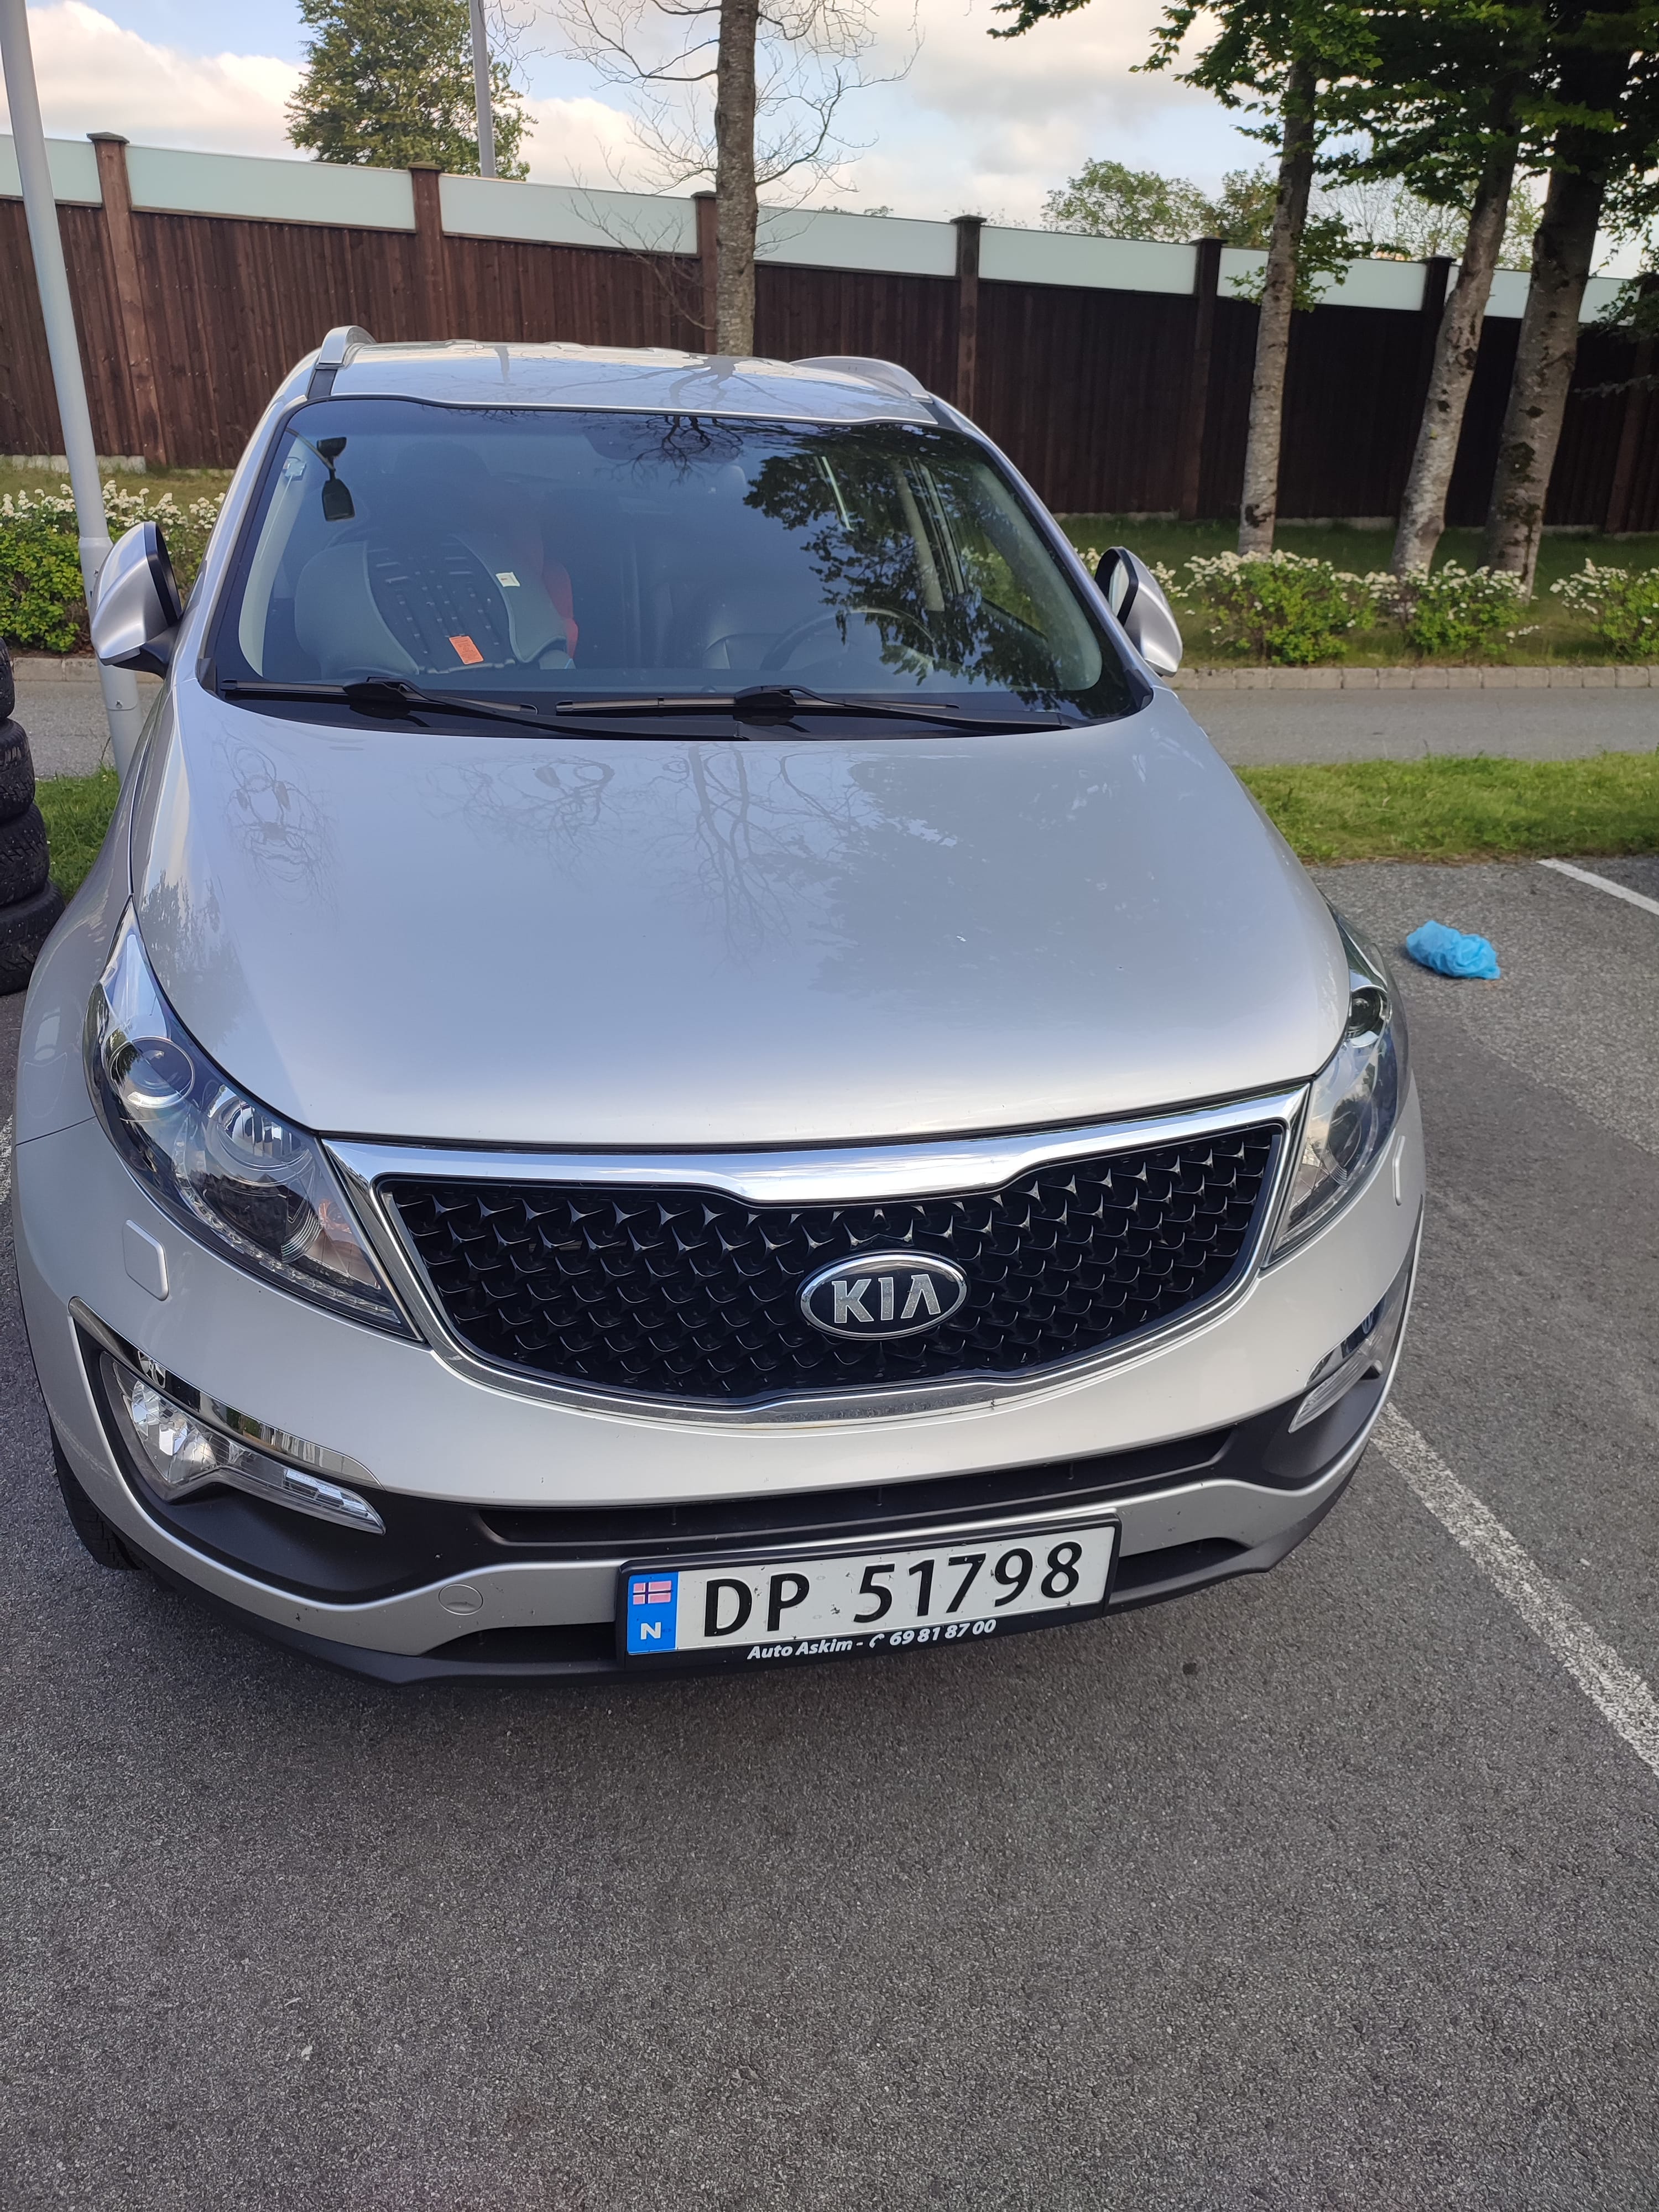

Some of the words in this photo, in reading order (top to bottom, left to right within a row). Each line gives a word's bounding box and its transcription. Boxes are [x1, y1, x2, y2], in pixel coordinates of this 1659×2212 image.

[831, 1274, 941, 1323] KIA
[704, 1573, 810, 1637] DP
[853, 1541, 1082, 1624] 51798
[640, 1621, 662, 1641] N
[747, 1645, 793, 1660] Auto
[795, 1639, 853, 1656] Askim
[889, 1630, 915, 1646] 69
[917, 1627, 941, 1643] 81
[945, 1622, 971, 1639] 87
[972, 1619, 997, 1635] 00
